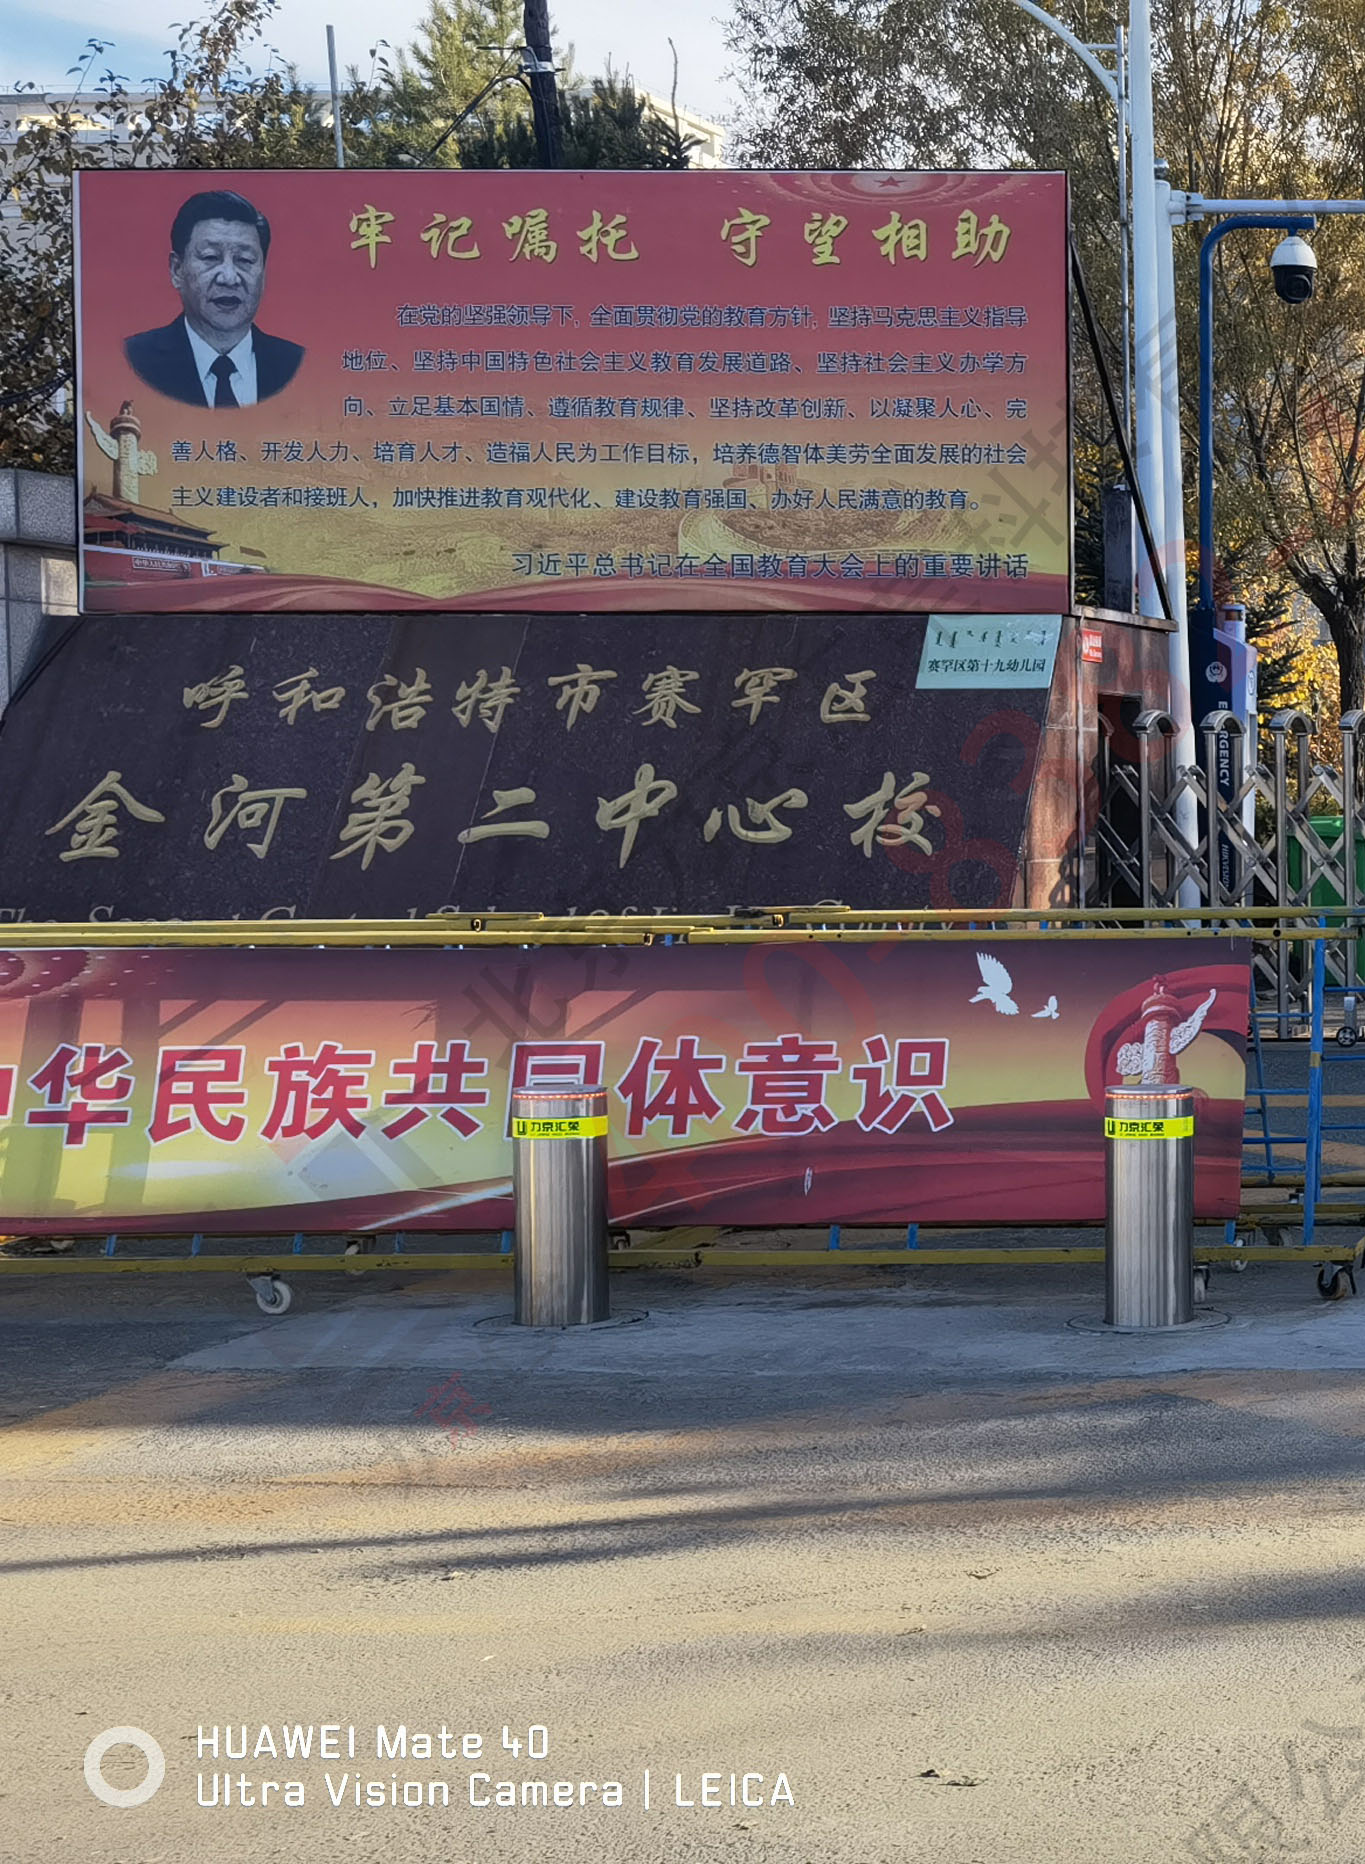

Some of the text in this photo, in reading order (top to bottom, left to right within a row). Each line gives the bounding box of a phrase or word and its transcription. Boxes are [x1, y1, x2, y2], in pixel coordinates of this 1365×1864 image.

[346, 205, 1010, 268] 牢记嘱托 守望相助
[511, 552, 1029, 579] 习近平总书记在全国教育大会上的重要讲话
[181, 662, 877, 734] 呼和浩特市赛罕区
[927, 658, 1046, 673] 赛罕区第十九幼儿园
[1217, 700, 1232, 787] ERGENCY
[46, 760, 942, 871] 金河第二中心校
[0, 1034, 956, 1147] 华民族共体意识
